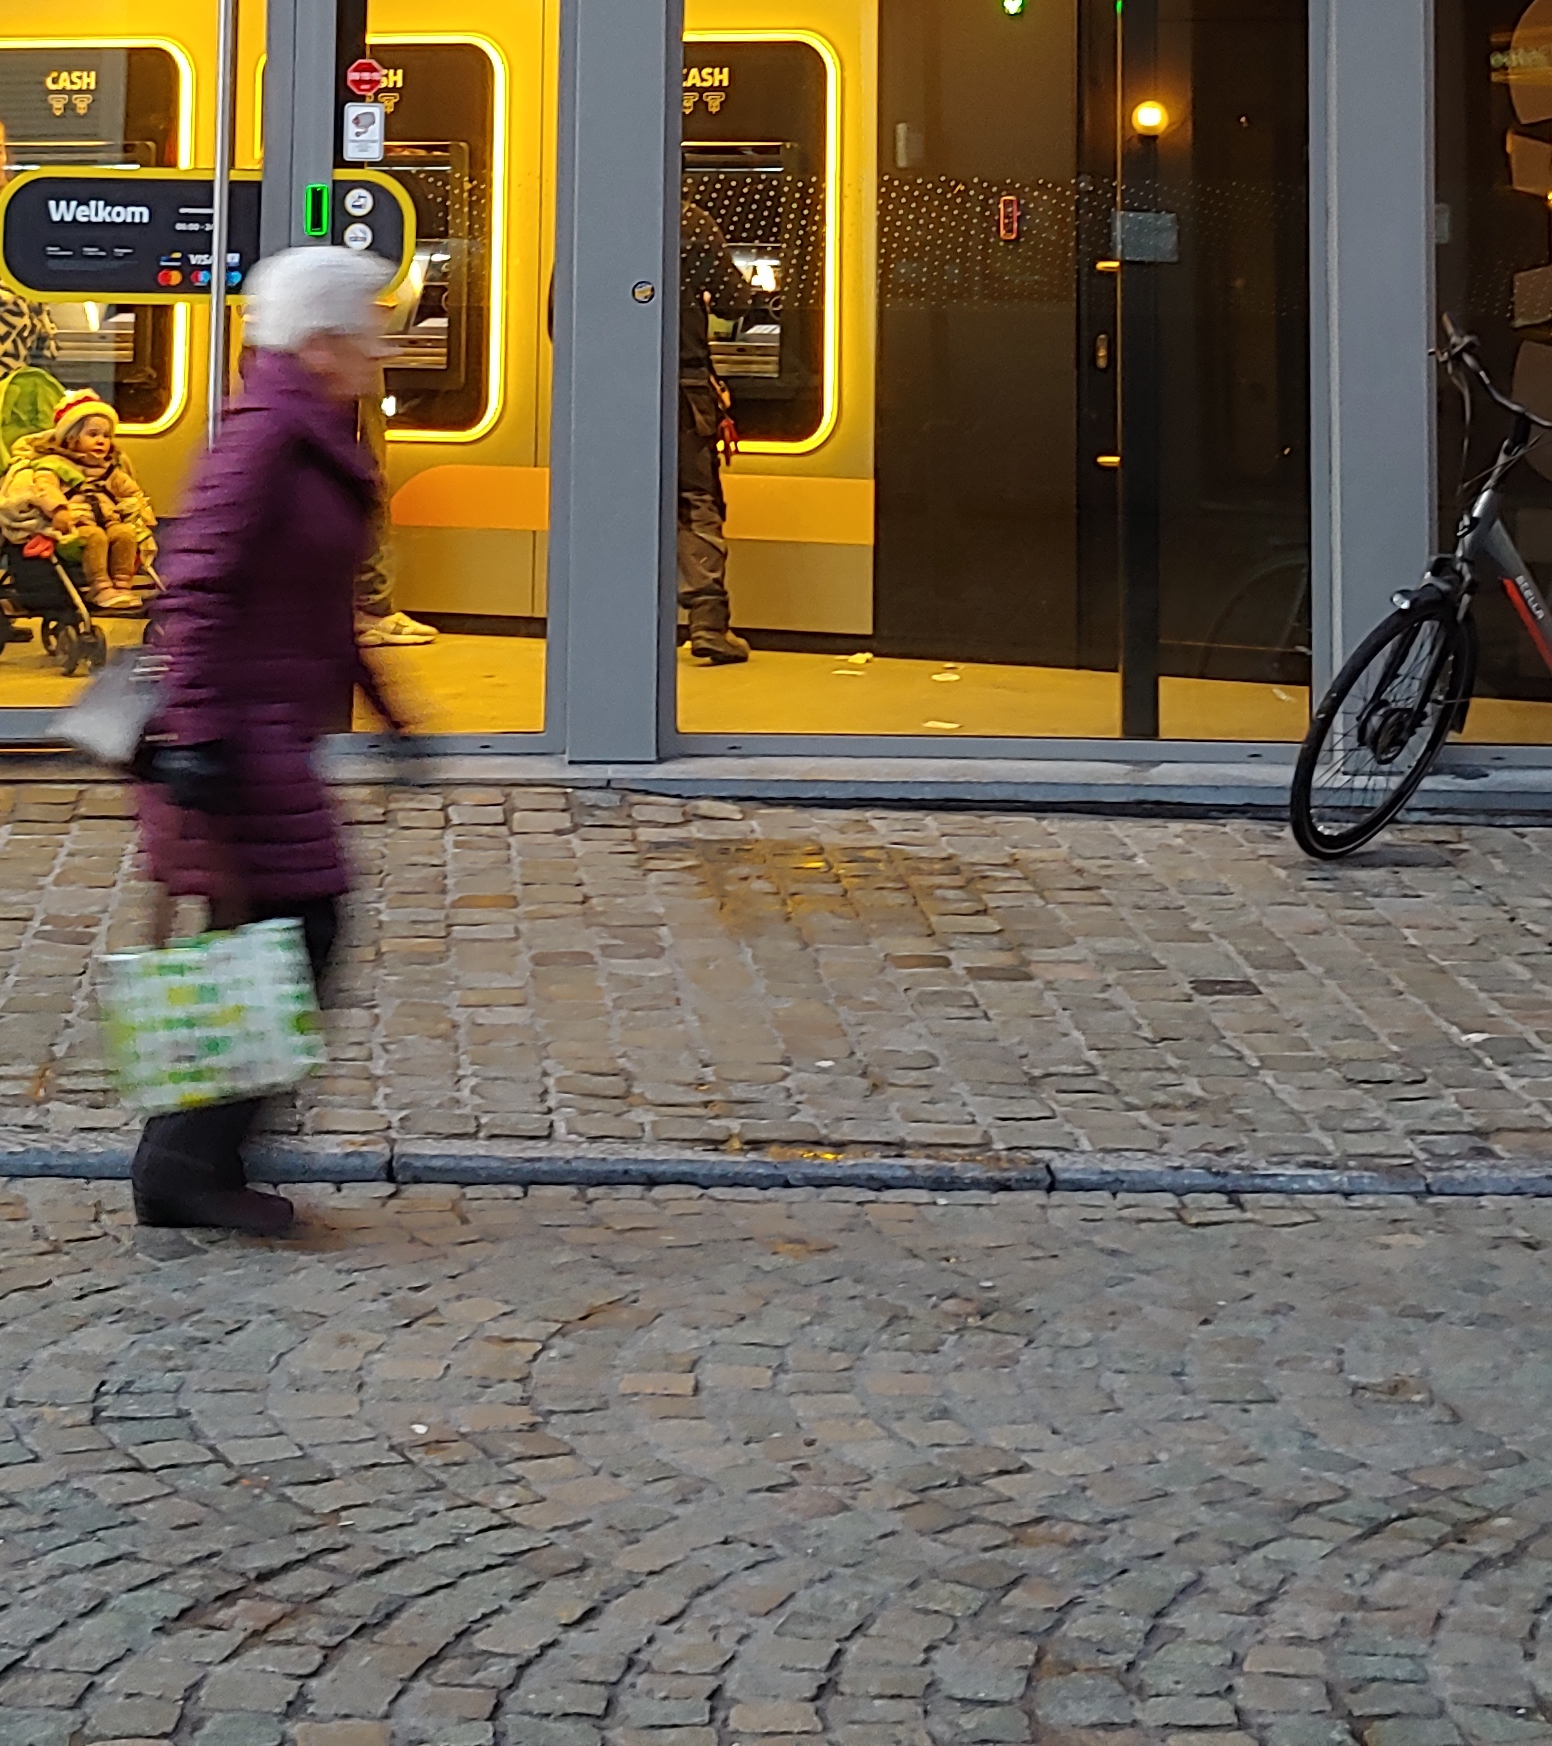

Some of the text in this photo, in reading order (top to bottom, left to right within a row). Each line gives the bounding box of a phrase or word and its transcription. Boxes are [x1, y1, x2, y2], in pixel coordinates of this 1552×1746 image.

[45, 70, 97, 91] CASH
[379, 68, 404, 89] SH
[48, 200, 150, 224] Welkom
